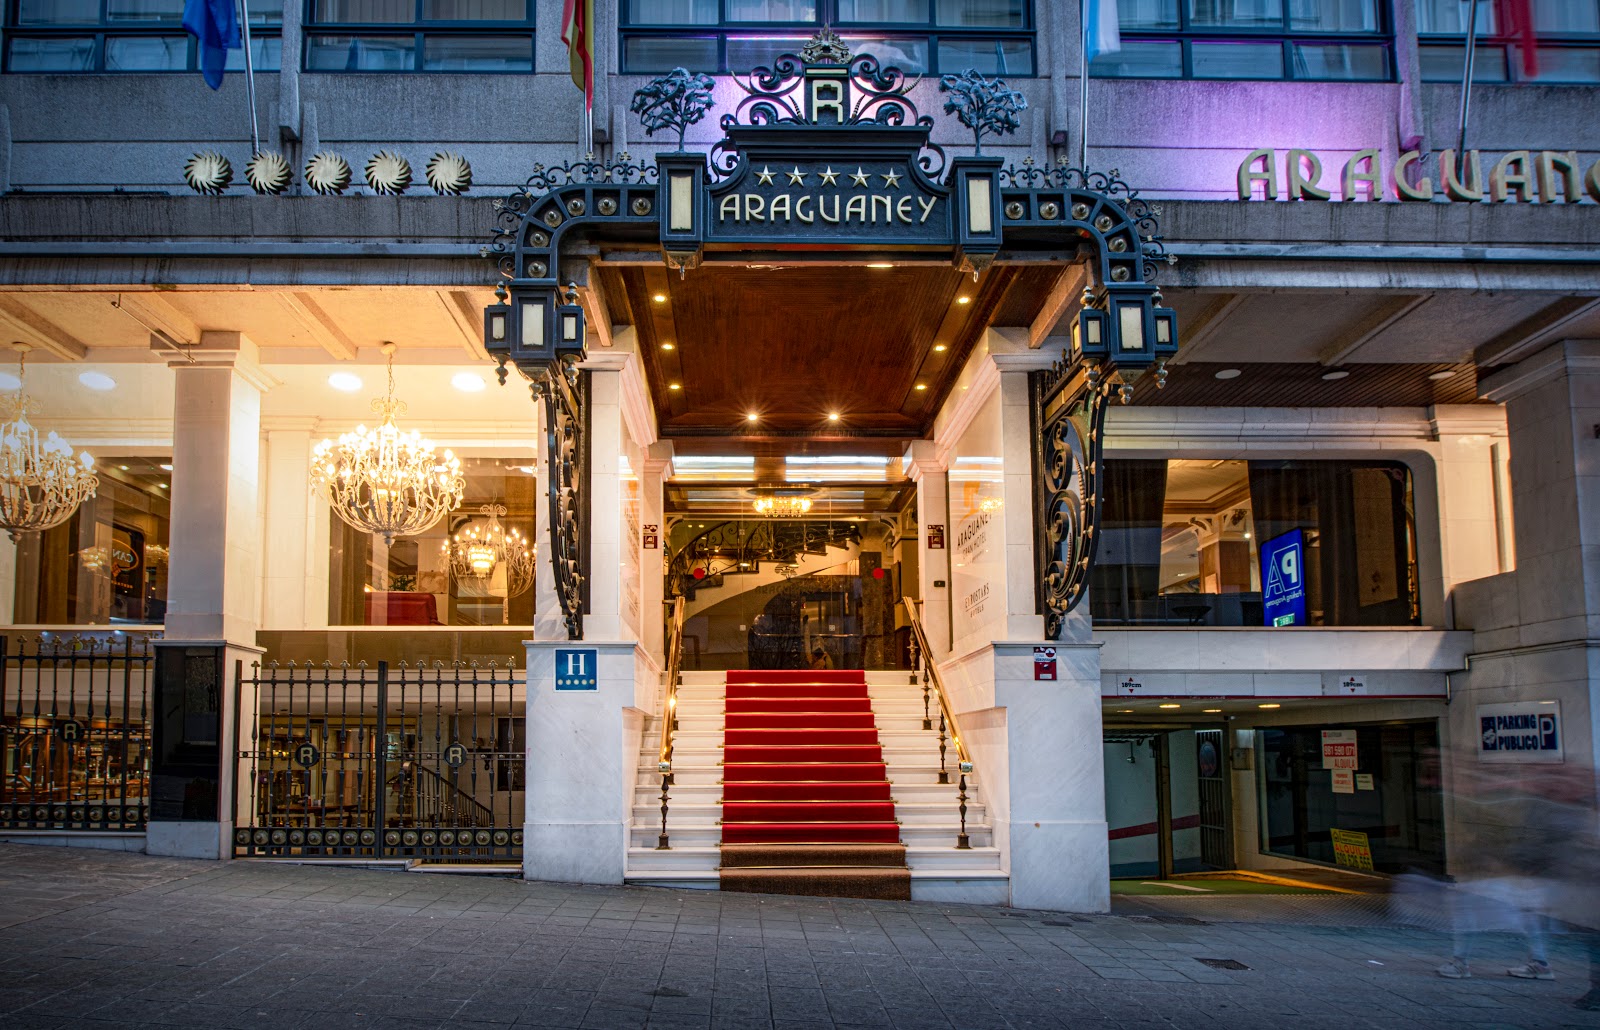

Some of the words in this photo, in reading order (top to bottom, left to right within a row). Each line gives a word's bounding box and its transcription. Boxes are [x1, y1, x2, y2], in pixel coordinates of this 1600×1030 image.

[811, 79, 844, 125] R
[719, 193, 938, 225] ARAGUANEY
[566, 653, 586, 676] H
[1497, 714, 1537, 730] PARKING
[1541, 717, 1554, 747] P
[1345, 745, 1355, 756] 071
[1498, 735, 1539, 751] PUBLICO
[1334, 758, 1355, 769] ALQUILA
[1335, 843, 1369, 857] ALQUILA
